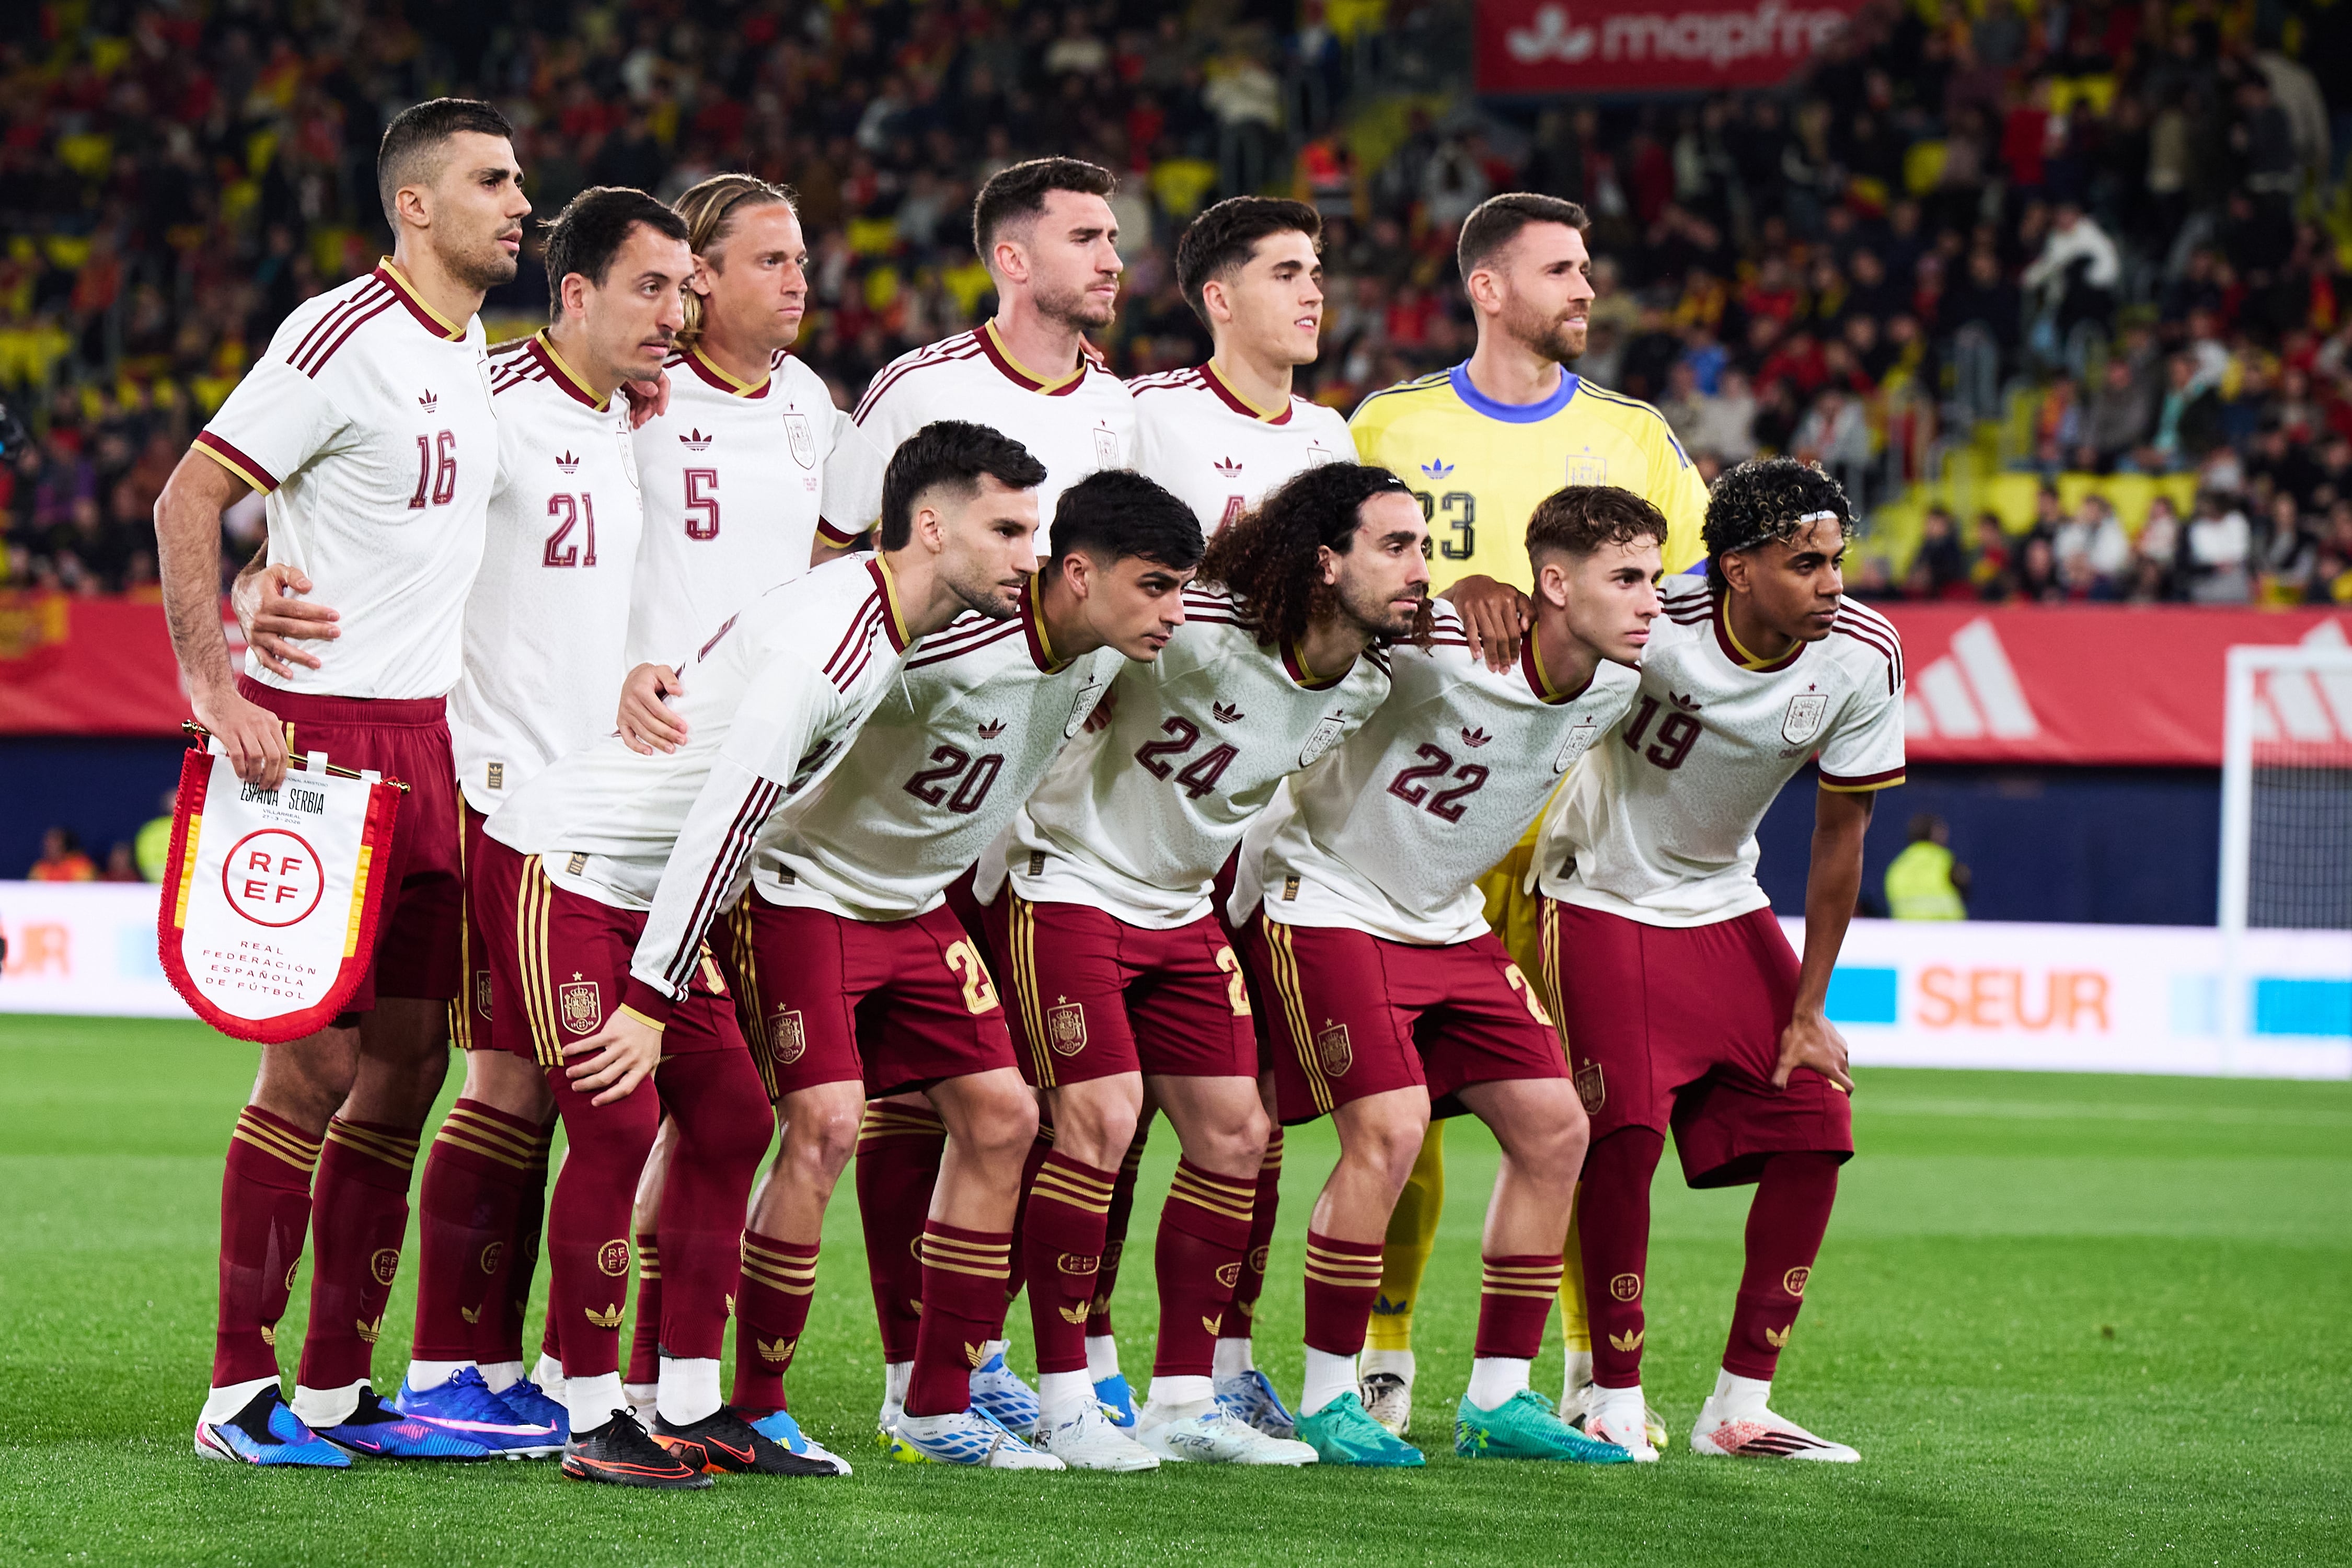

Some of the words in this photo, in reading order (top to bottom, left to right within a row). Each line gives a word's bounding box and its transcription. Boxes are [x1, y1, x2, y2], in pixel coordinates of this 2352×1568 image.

[408, 429, 457, 510] 16
[683, 467, 720, 541] 5
[542, 492, 597, 568] 21
[1622, 694, 1703, 770] 19
[1134, 716, 1240, 800] 24
[903, 744, 1005, 815] 20
[1387, 742, 1490, 824] 22
[262, 809, 302, 820] VILLARREAL
[289, 788, 325, 815] SERBIA
[249, 851, 303, 875] RF
[244, 879, 298, 904] EF
[240, 941, 284, 955] REAL
[203, 949, 317, 975] FEDERACIÓN
[945, 935, 1000, 1015] 2
[205, 977, 226, 986] DE
[237, 982, 305, 1000] FÚTBOL
[211, 964, 304, 987] ESPAÑOLA
[1916, 965, 2111, 1032] SEUR
[381, 1255, 397, 1266] RF
[608, 1247, 625, 1258] RF
[608, 1258, 627, 1269] EF
[380, 1266, 395, 1277] EF
